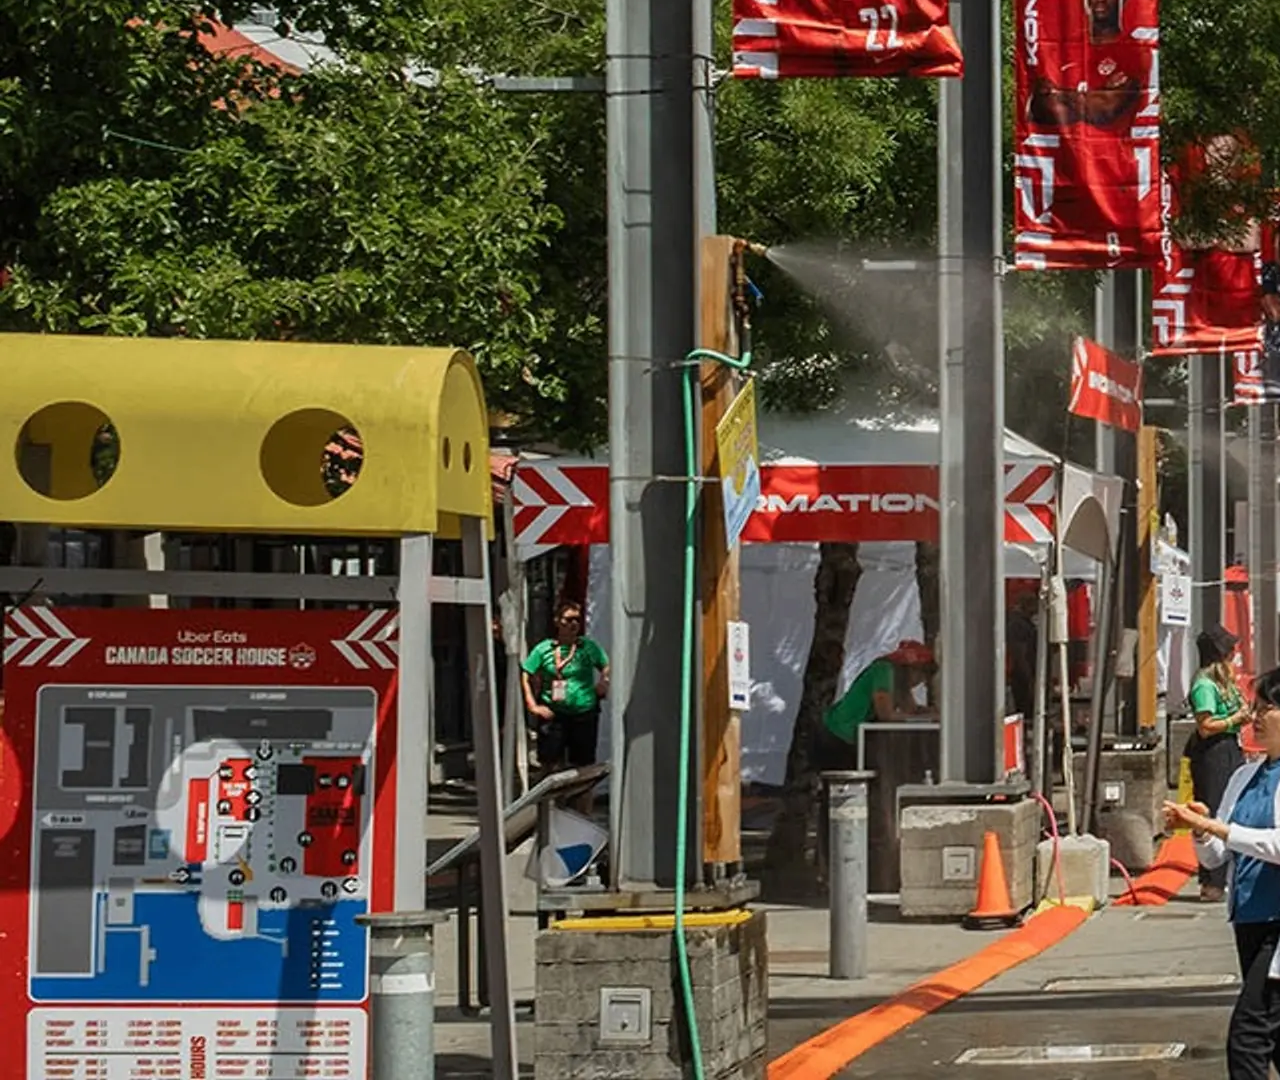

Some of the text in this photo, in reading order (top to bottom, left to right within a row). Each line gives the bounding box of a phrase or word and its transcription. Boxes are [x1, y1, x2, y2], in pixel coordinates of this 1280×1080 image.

[859, 4, 904, 51] 22
[754, 494, 940, 513] RMATION
[177, 630, 247, 644] Uber Eats
[105, 646, 287, 667] CANADA SOCCER HOUSE
